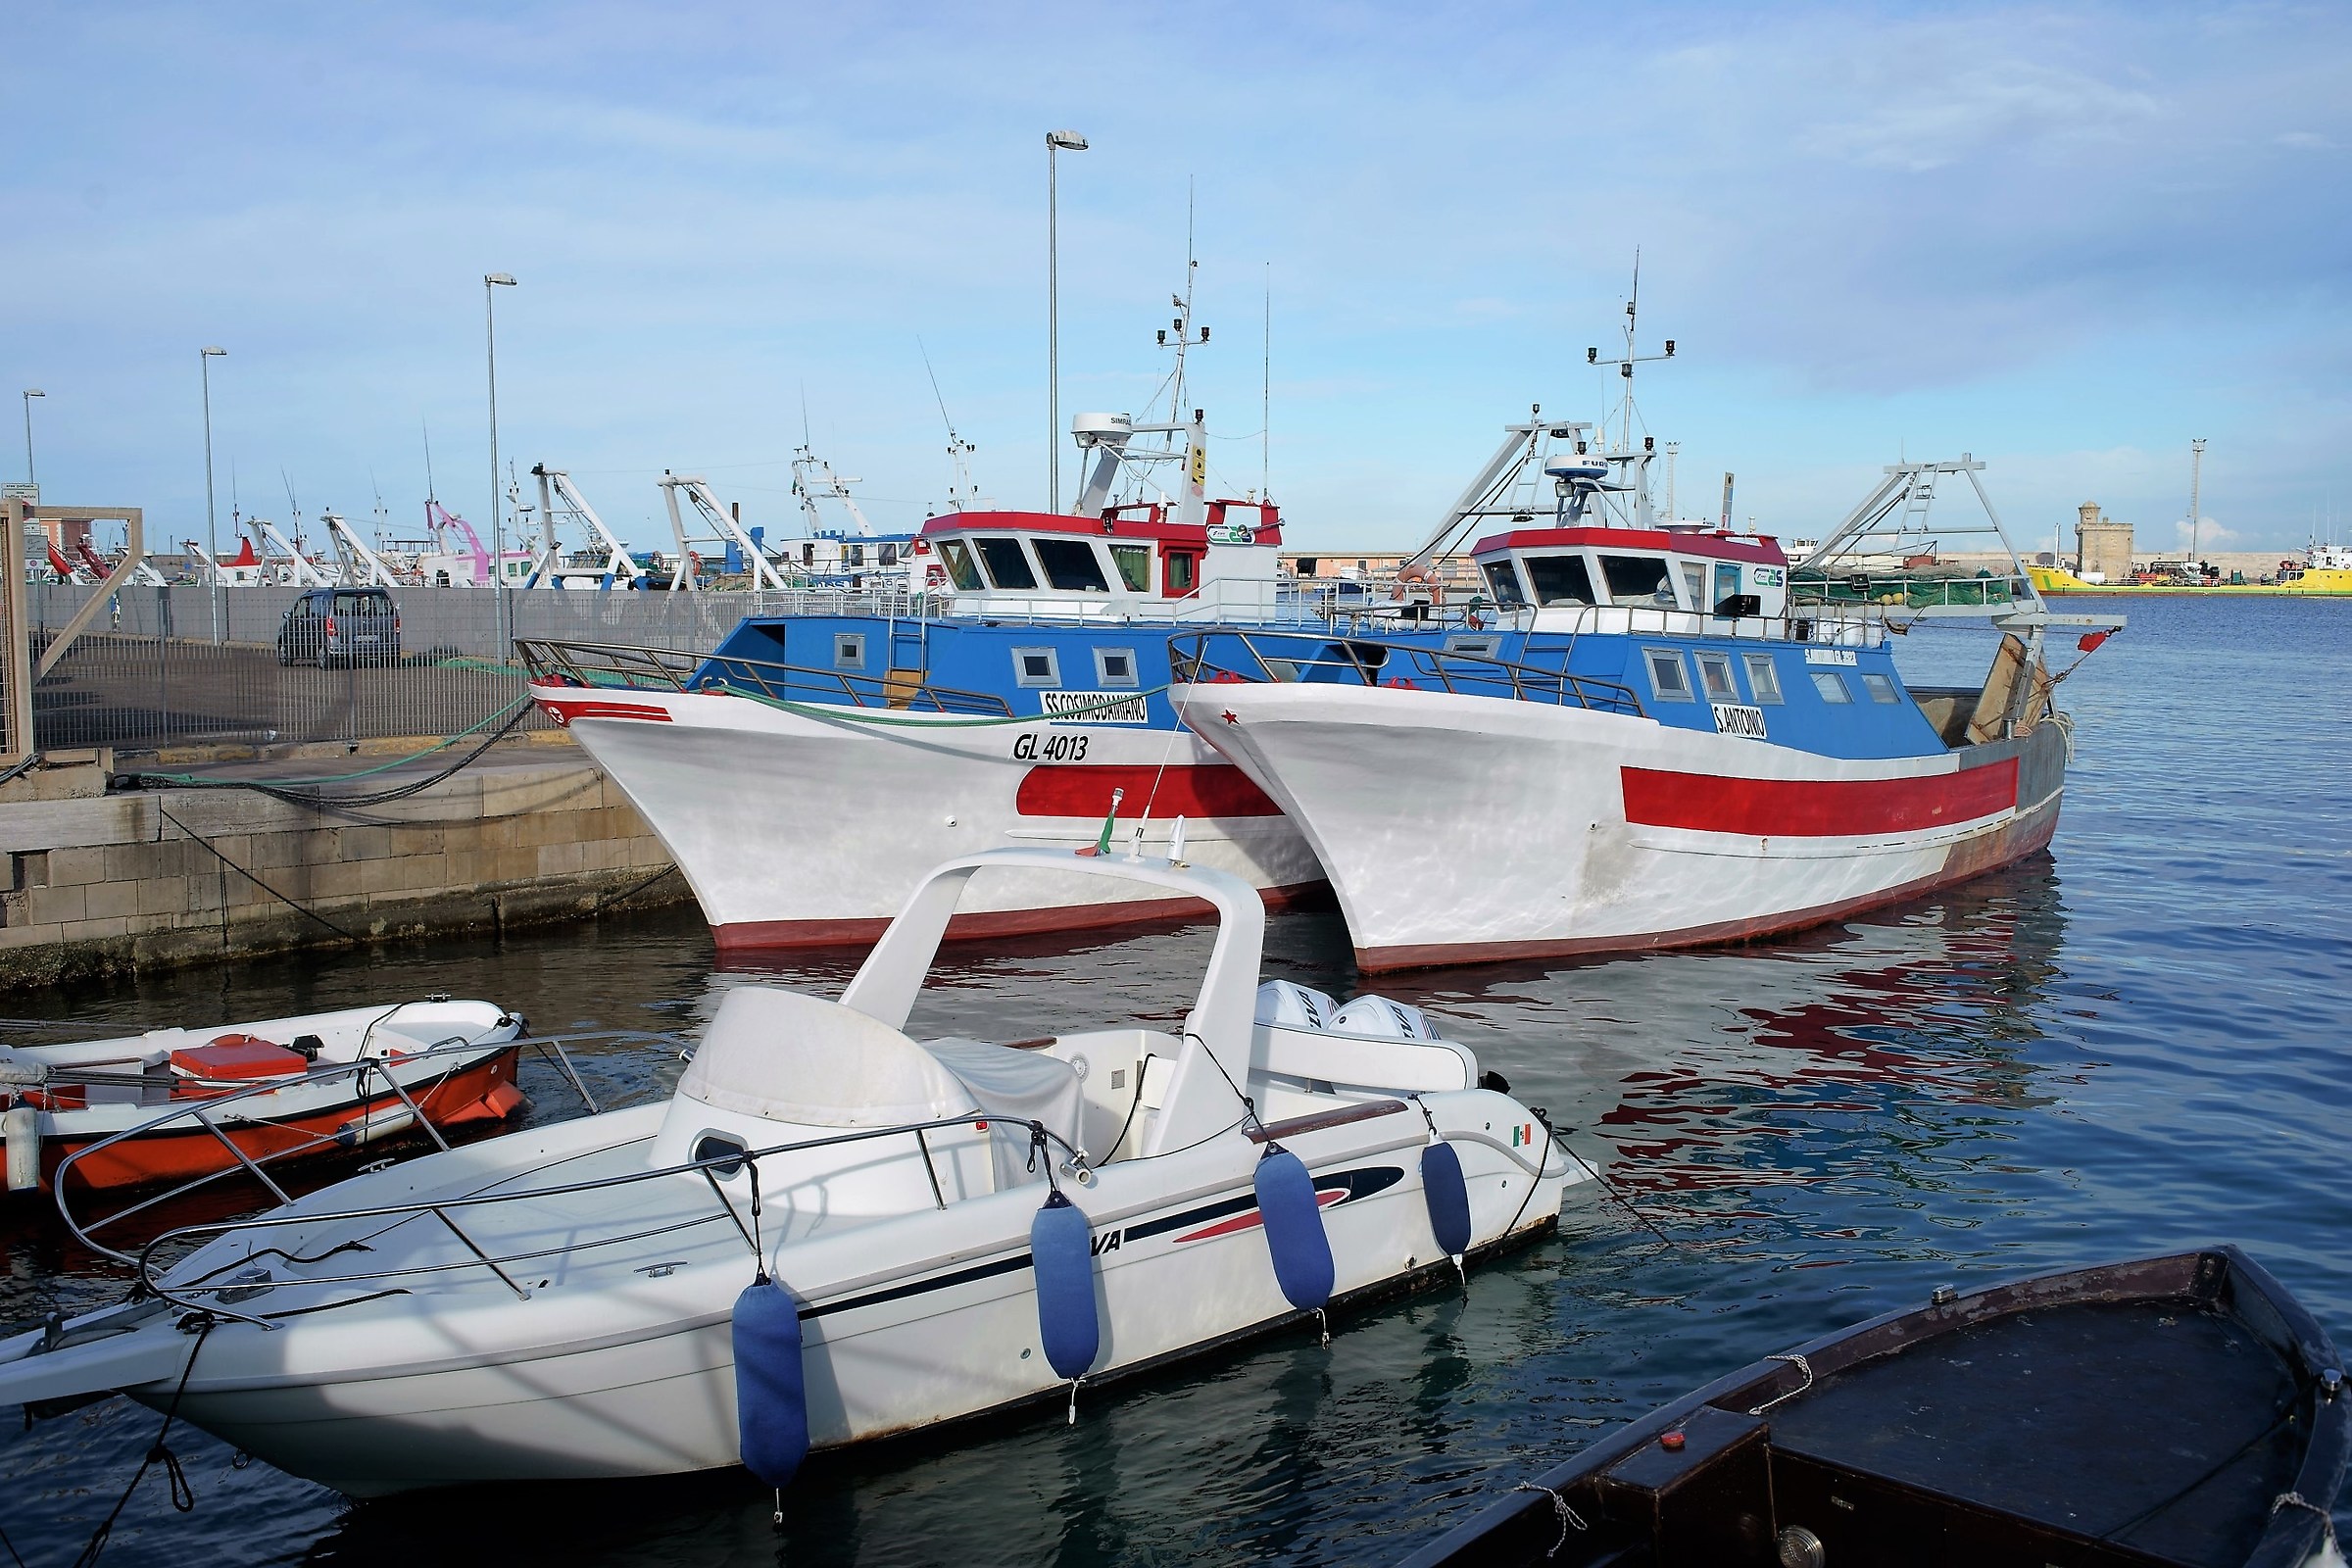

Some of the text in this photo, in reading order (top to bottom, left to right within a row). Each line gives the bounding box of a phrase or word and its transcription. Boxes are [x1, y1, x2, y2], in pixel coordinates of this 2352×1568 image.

[1714, 706, 1765, 737] S.ANTONIO
[1013, 734, 1089, 761] GL 4013
[1090, 1229, 1121, 1257] VA
